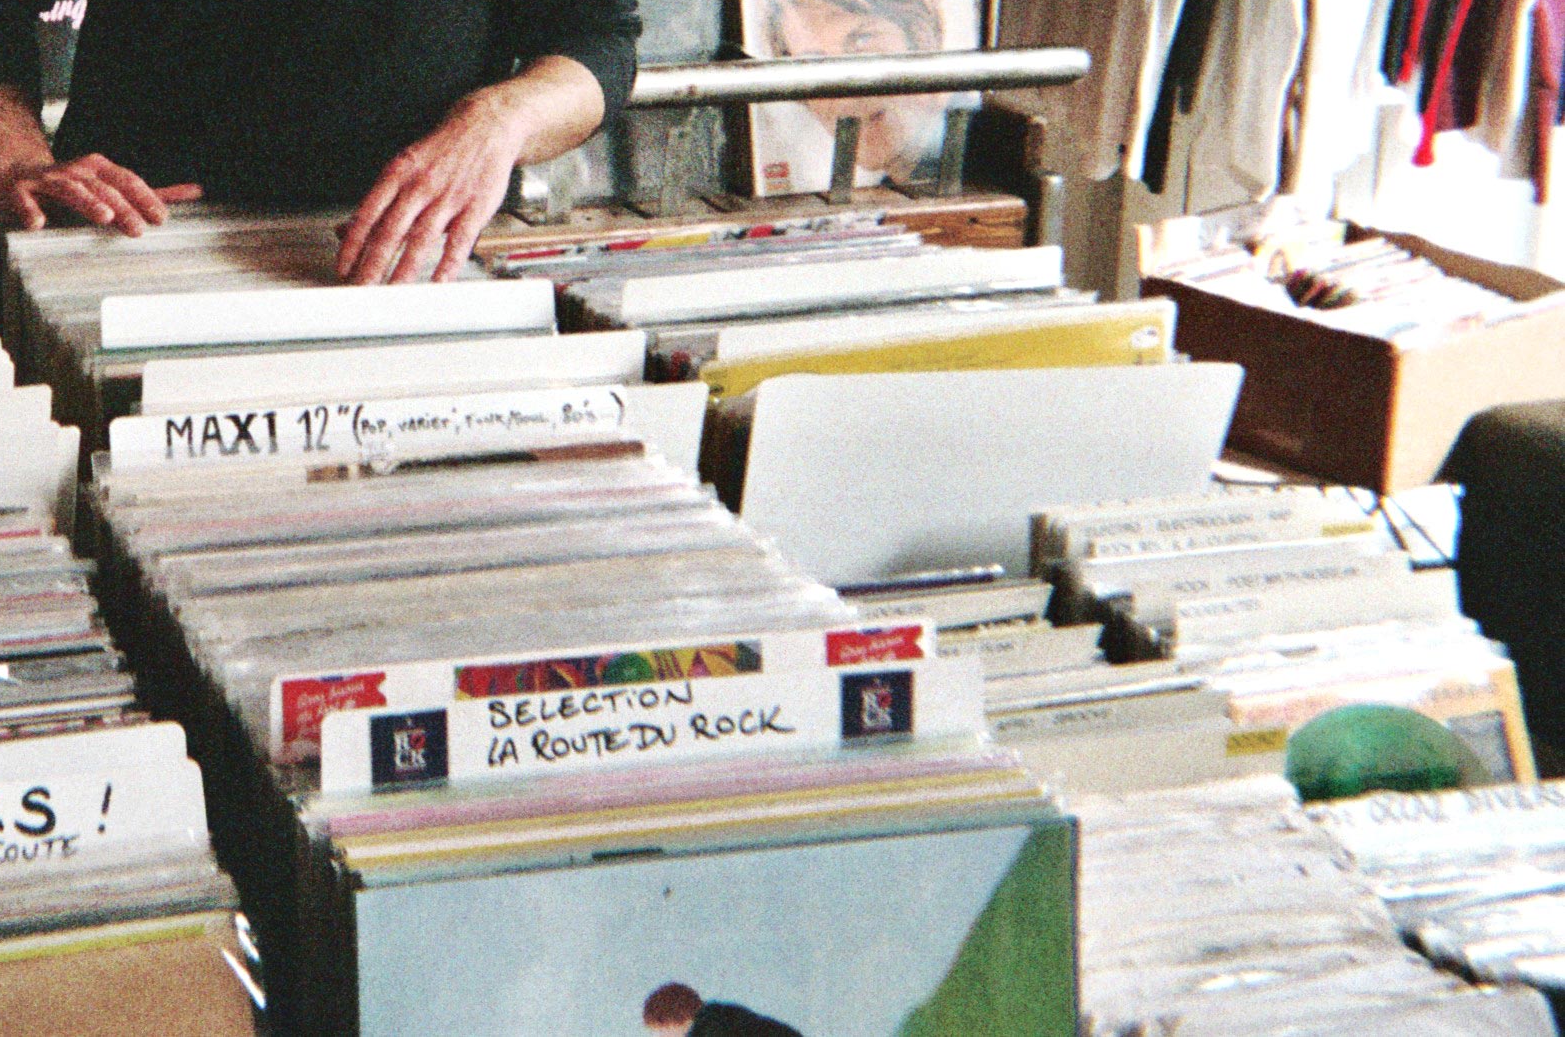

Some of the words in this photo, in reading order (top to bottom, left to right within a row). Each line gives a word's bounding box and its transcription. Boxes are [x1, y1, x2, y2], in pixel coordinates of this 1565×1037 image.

[487, 735, 519, 768] LA
[530, 728, 629, 763] ROUTE
[628, 722, 677, 751] DU
[689, 704, 796, 740] ROCK
[96, 781, 114, 835] !
